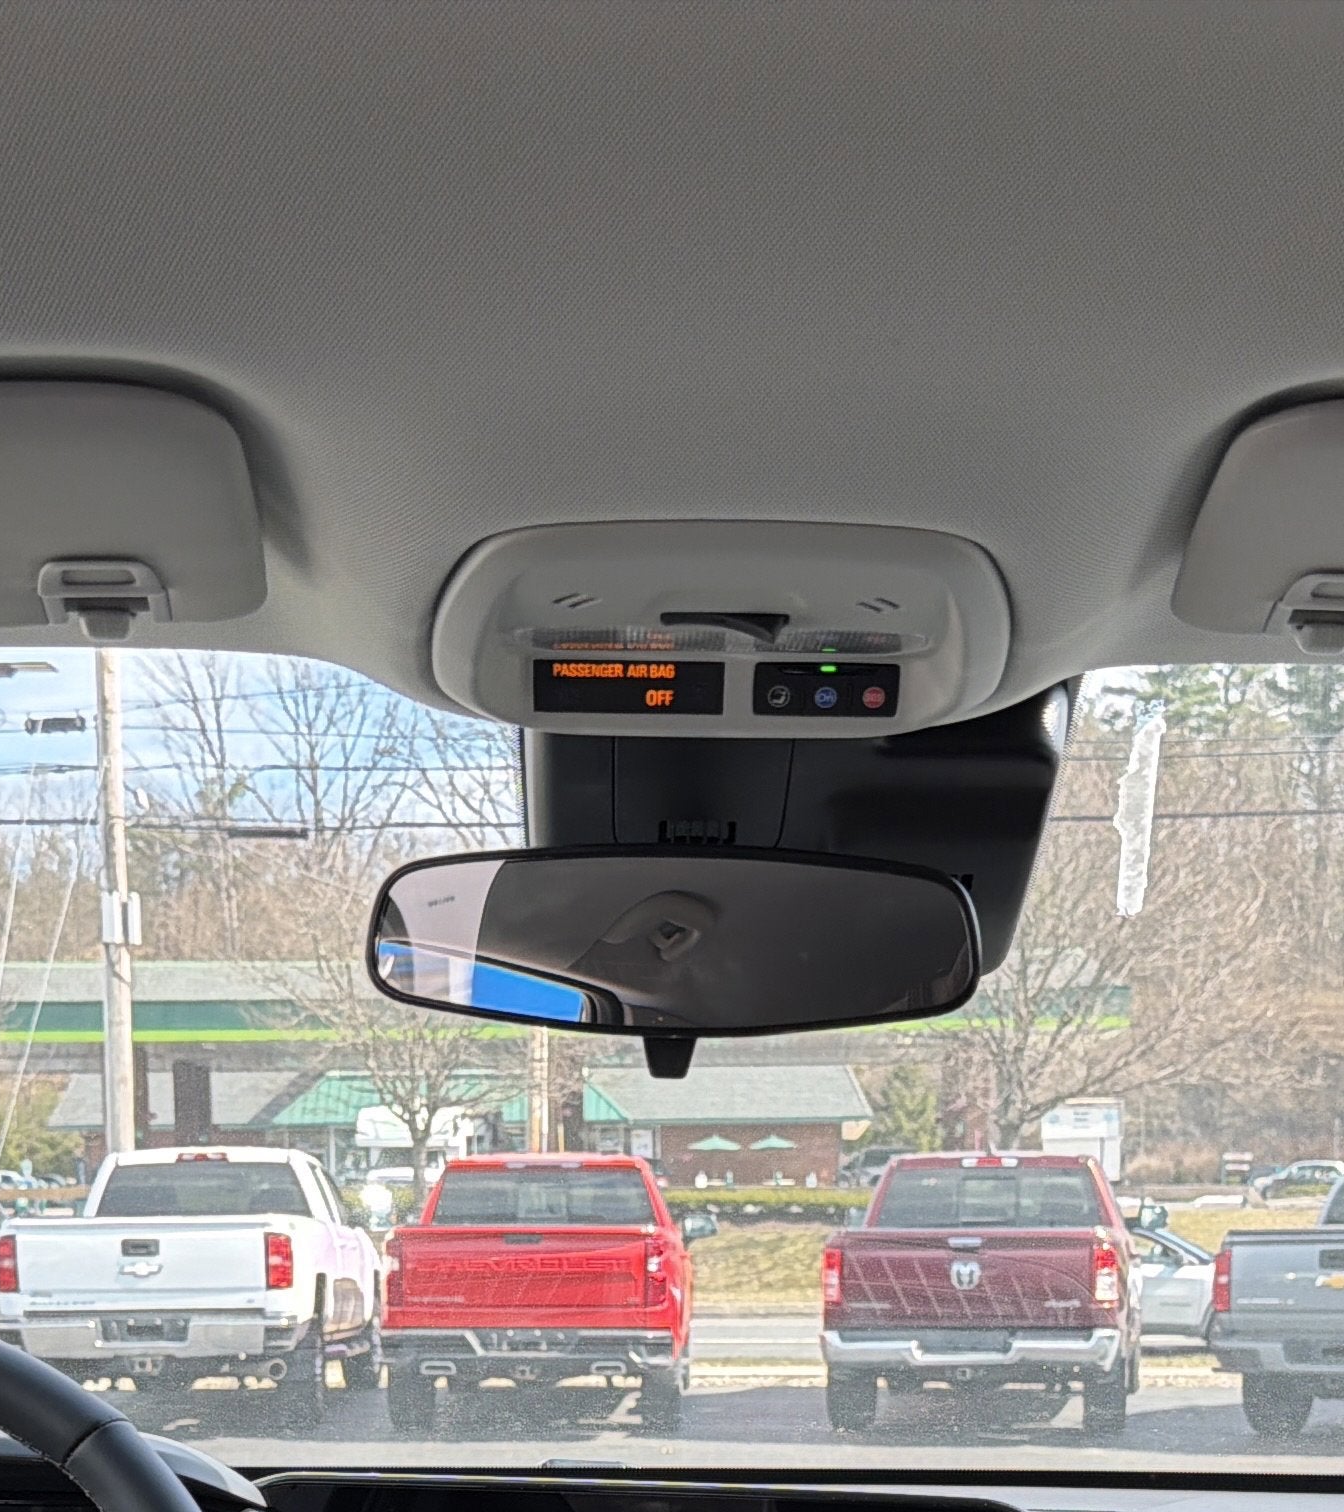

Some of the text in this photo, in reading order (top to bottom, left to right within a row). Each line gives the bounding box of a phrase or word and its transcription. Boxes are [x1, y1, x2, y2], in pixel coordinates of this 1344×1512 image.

[552, 663, 675, 679] PASSENGER AIR BAG
[645, 689, 674, 706] OFF
[416, 1258, 631, 1272] CHEVROLET
